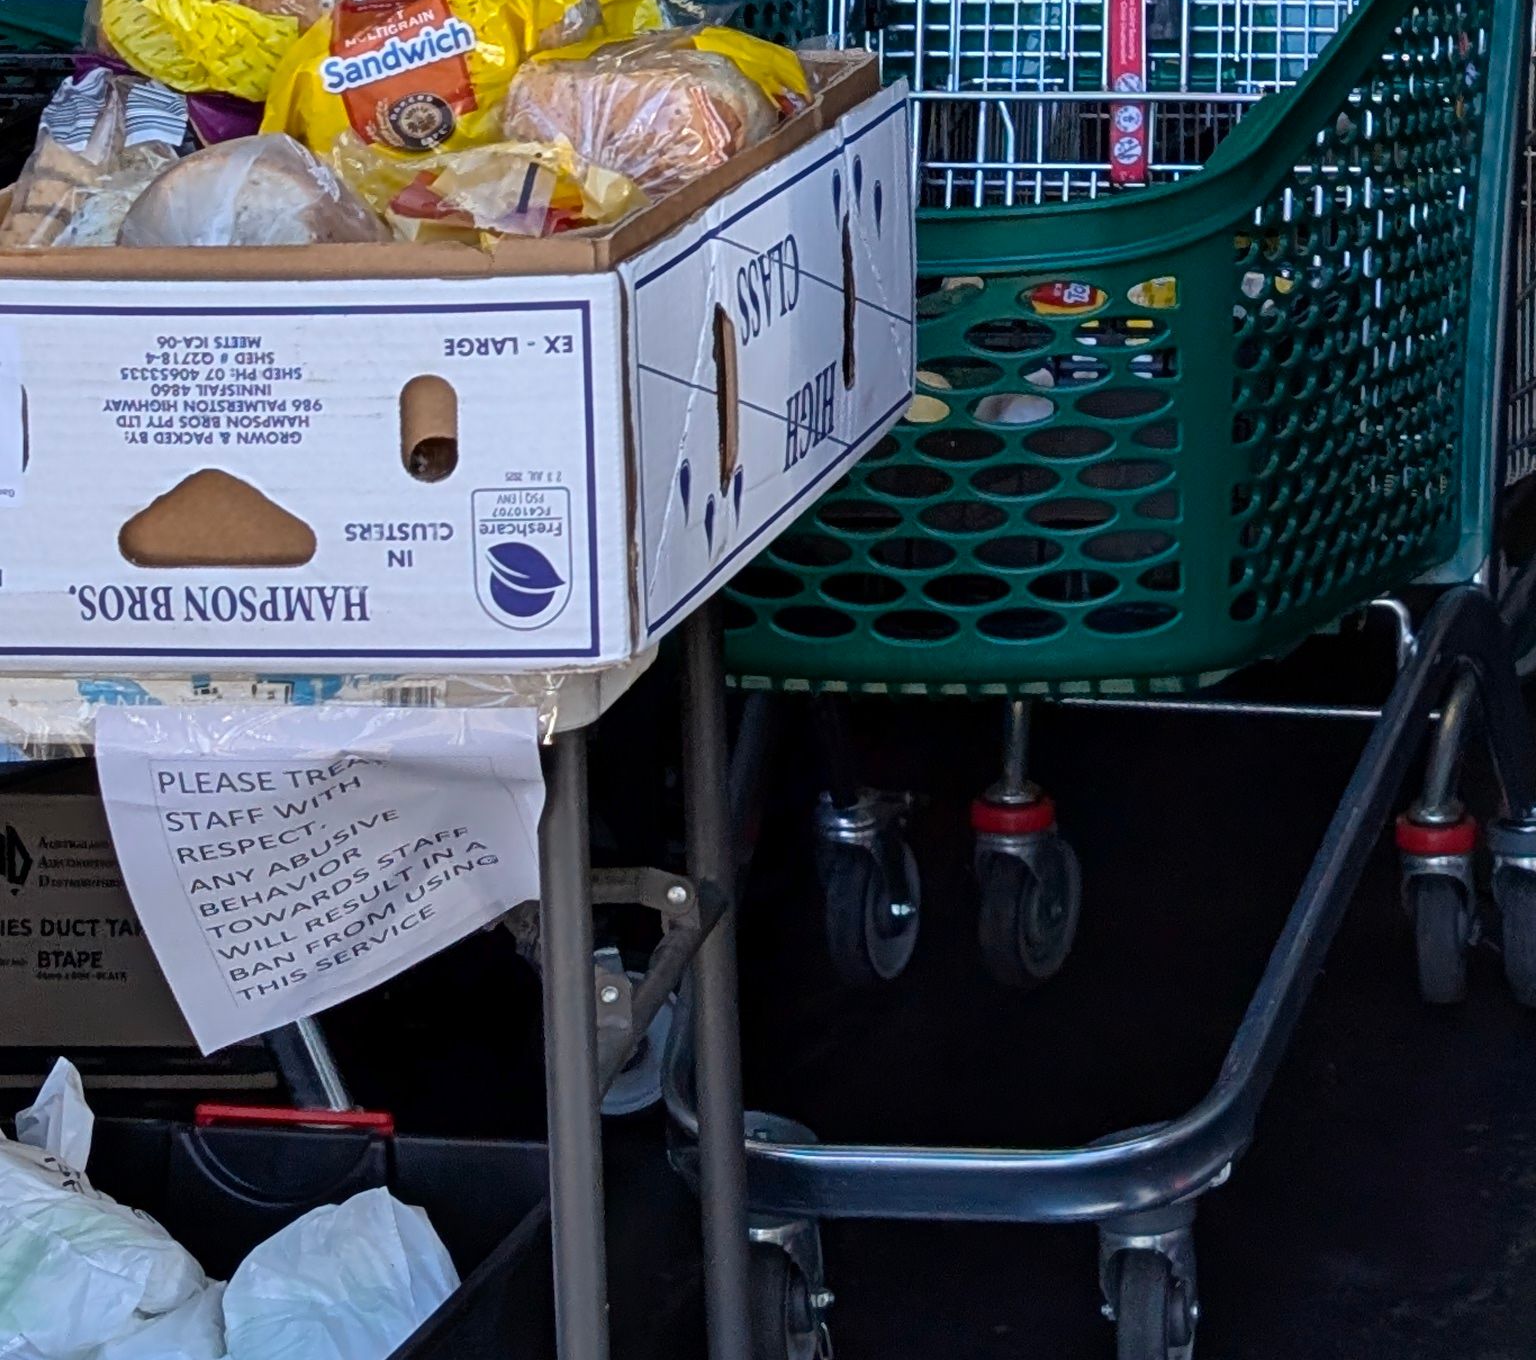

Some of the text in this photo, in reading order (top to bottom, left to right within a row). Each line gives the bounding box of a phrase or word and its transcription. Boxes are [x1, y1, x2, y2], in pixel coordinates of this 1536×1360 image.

[324, 22, 472, 89] Sandwich
[737, 233, 800, 347] CLASS
[156, 335, 262, 349] MEETS ICA-06
[443, 337, 519, 357] LARGE
[544, 336, 573, 355] EX
[145, 351, 214, 365] Q2718-4
[235, 351, 275, 365] SHED
[120, 367, 303, 381] SHED PH: 07 40653335
[150, 383, 272, 397] INNISFAIL 4860
[102, 398, 323, 413] 986 PALMERSTON HIGHWAY
[115, 414, 310, 429] HAMPSON BROS PTY LTD
[783, 360, 837, 473] HIGH
[125, 431, 303, 445] GROWN & PACKED BY:
[344, 522, 454, 542] CLUSTERS
[479, 521, 562, 537] Freshcare
[388, 550, 413, 568] IN
[69, 585, 371, 622] HAMPSON BROS.
[157, 771, 278, 795] PLEASE
[165, 775, 361, 832] STAFF WITH
[176, 820, 327, 865] RESPECT.
[190, 809, 400, 894] ANY ABUSIVE
[199, 846, 363, 918] BEHAVIOR
[205, 826, 469, 940] TOWARDS STAFF
[217, 841, 488, 961] WILL RESULT IN A
[40, 918, 99, 937] DUCT
[229, 854, 500, 982] BAN FROM USING
[37, 950, 103, 969] BTAPE
[236, 903, 437, 1001] THIS SERVICE
